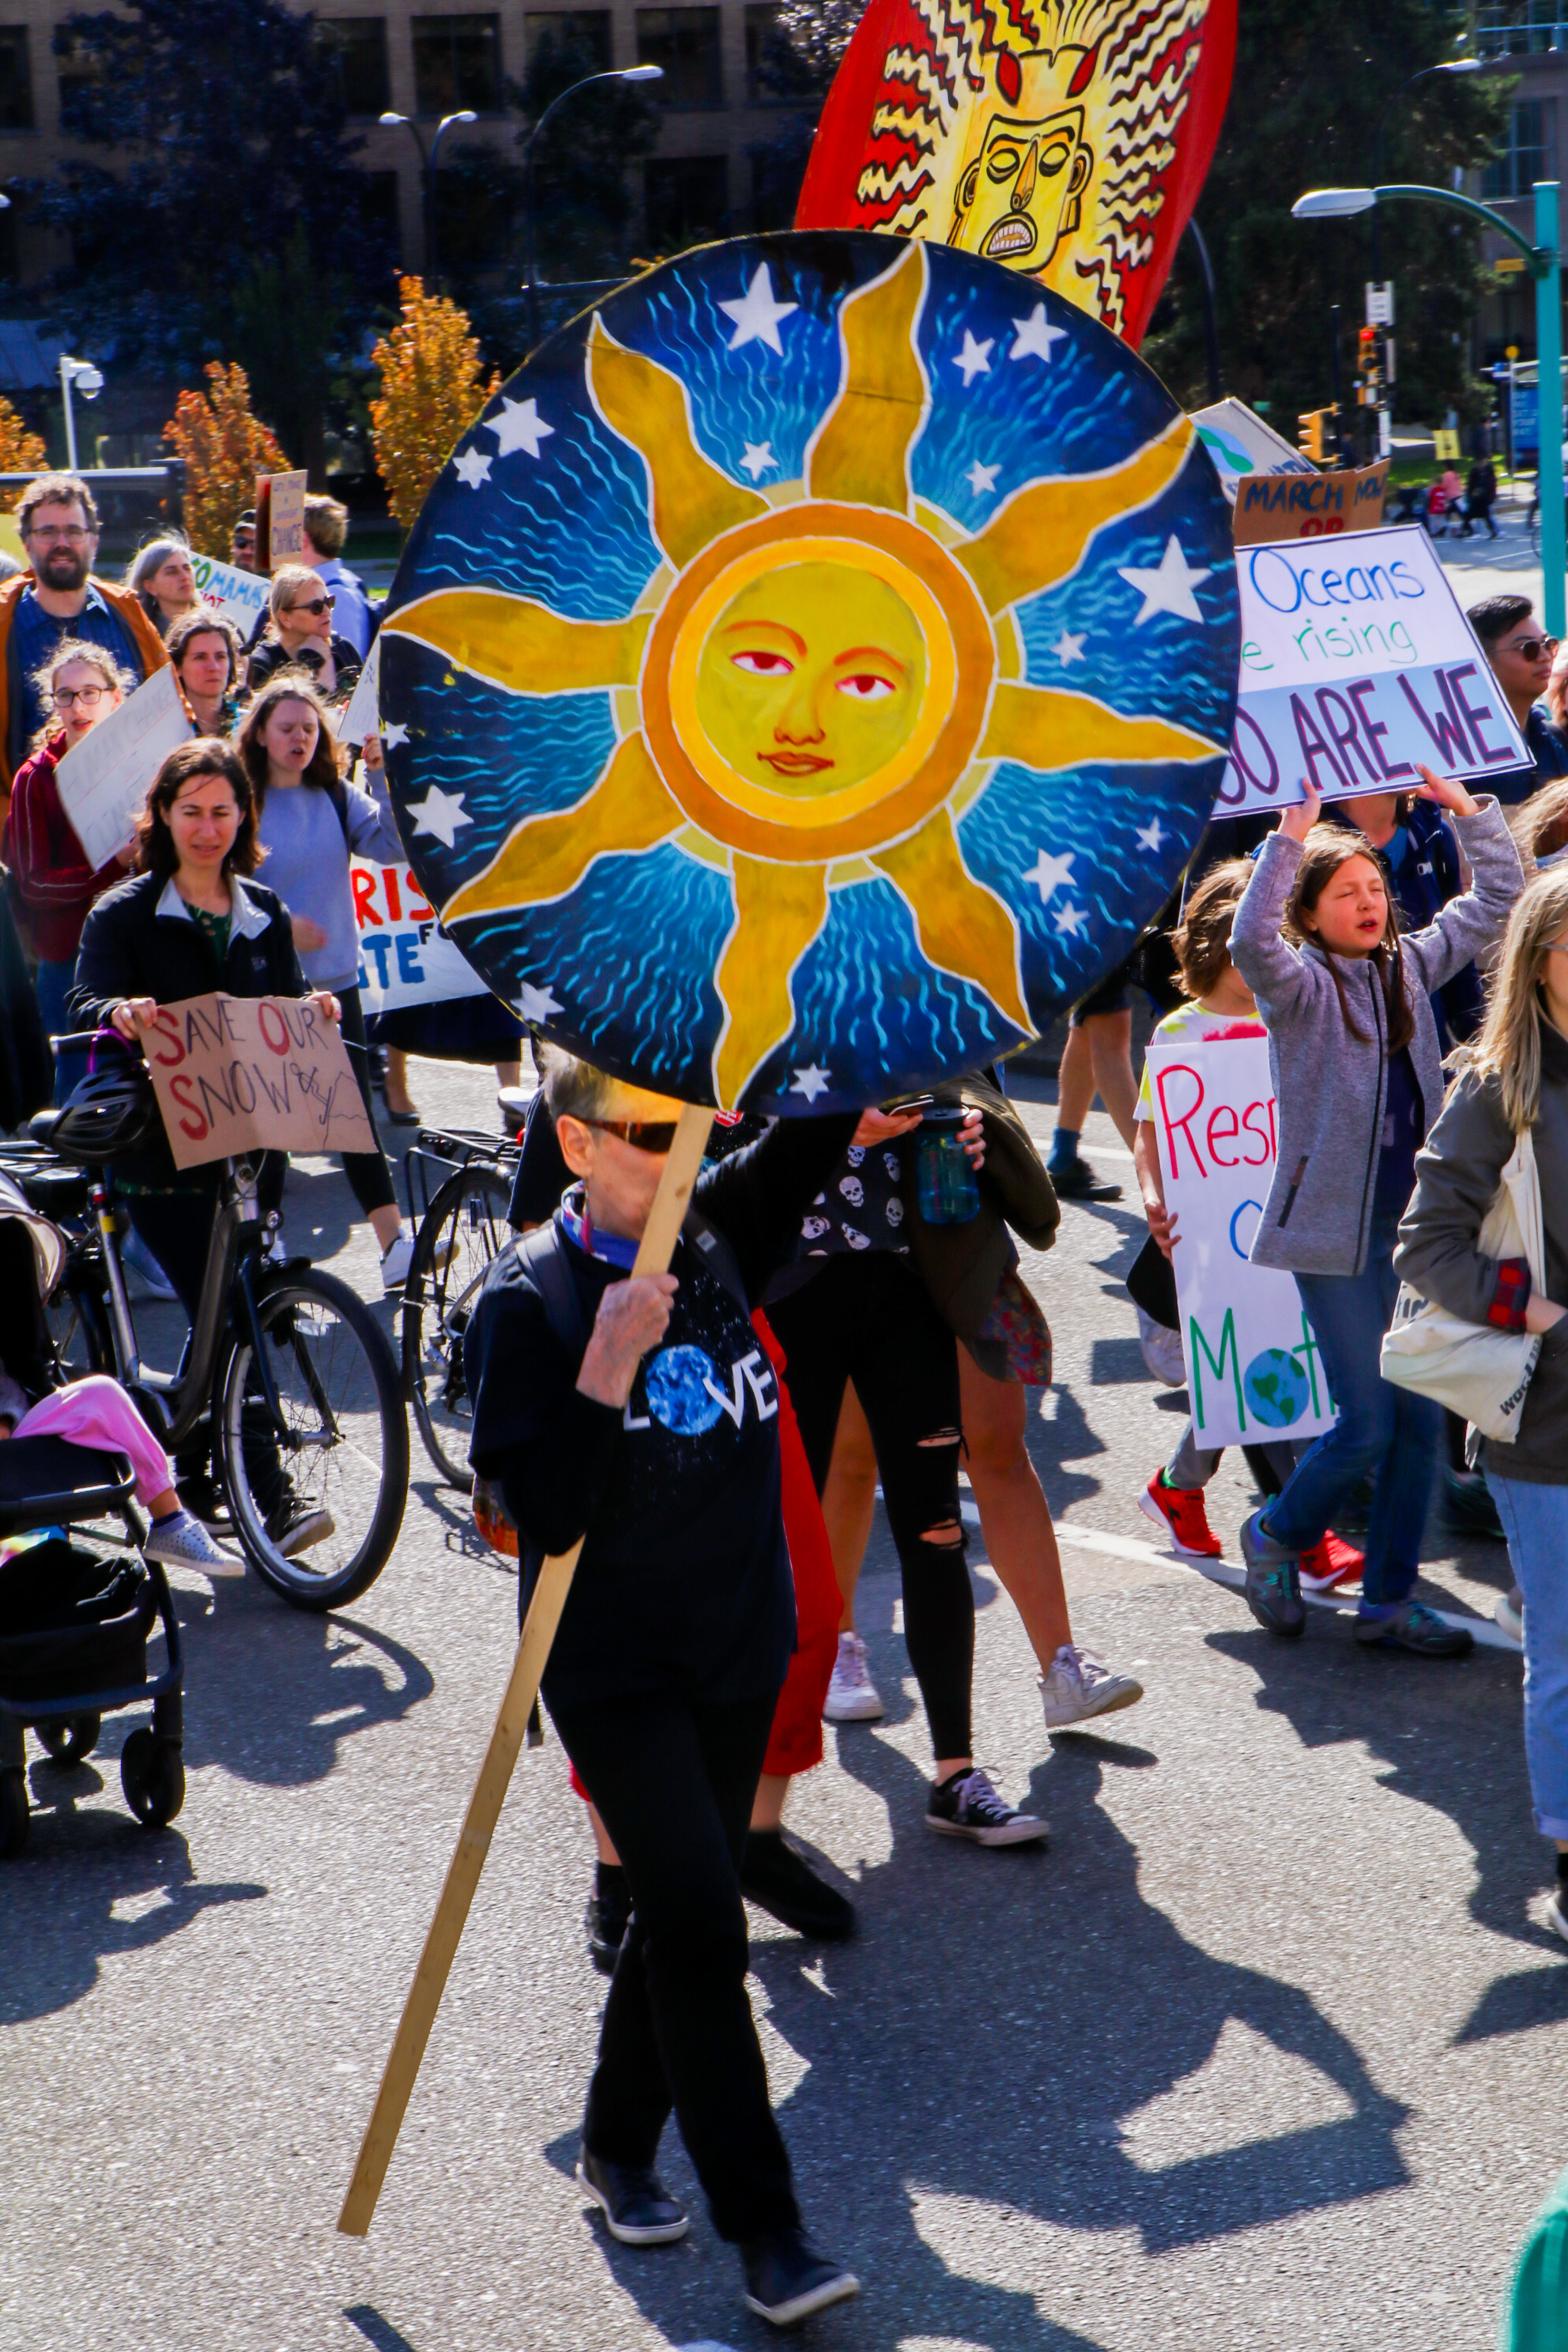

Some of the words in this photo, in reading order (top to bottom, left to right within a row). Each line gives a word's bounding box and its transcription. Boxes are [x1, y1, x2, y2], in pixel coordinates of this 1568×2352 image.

[1244, 480, 1344, 512] MARCH
[1250, 548, 1425, 612] Oceans
[1291, 617, 1419, 665] rising
[1290, 679, 1415, 792] ARE
[1397, 662, 1517, 770] WE
[155, 999, 246, 1066] SAVE
[258, 1001, 330, 1056] OUR
[169, 1060, 291, 1140] SNOW
